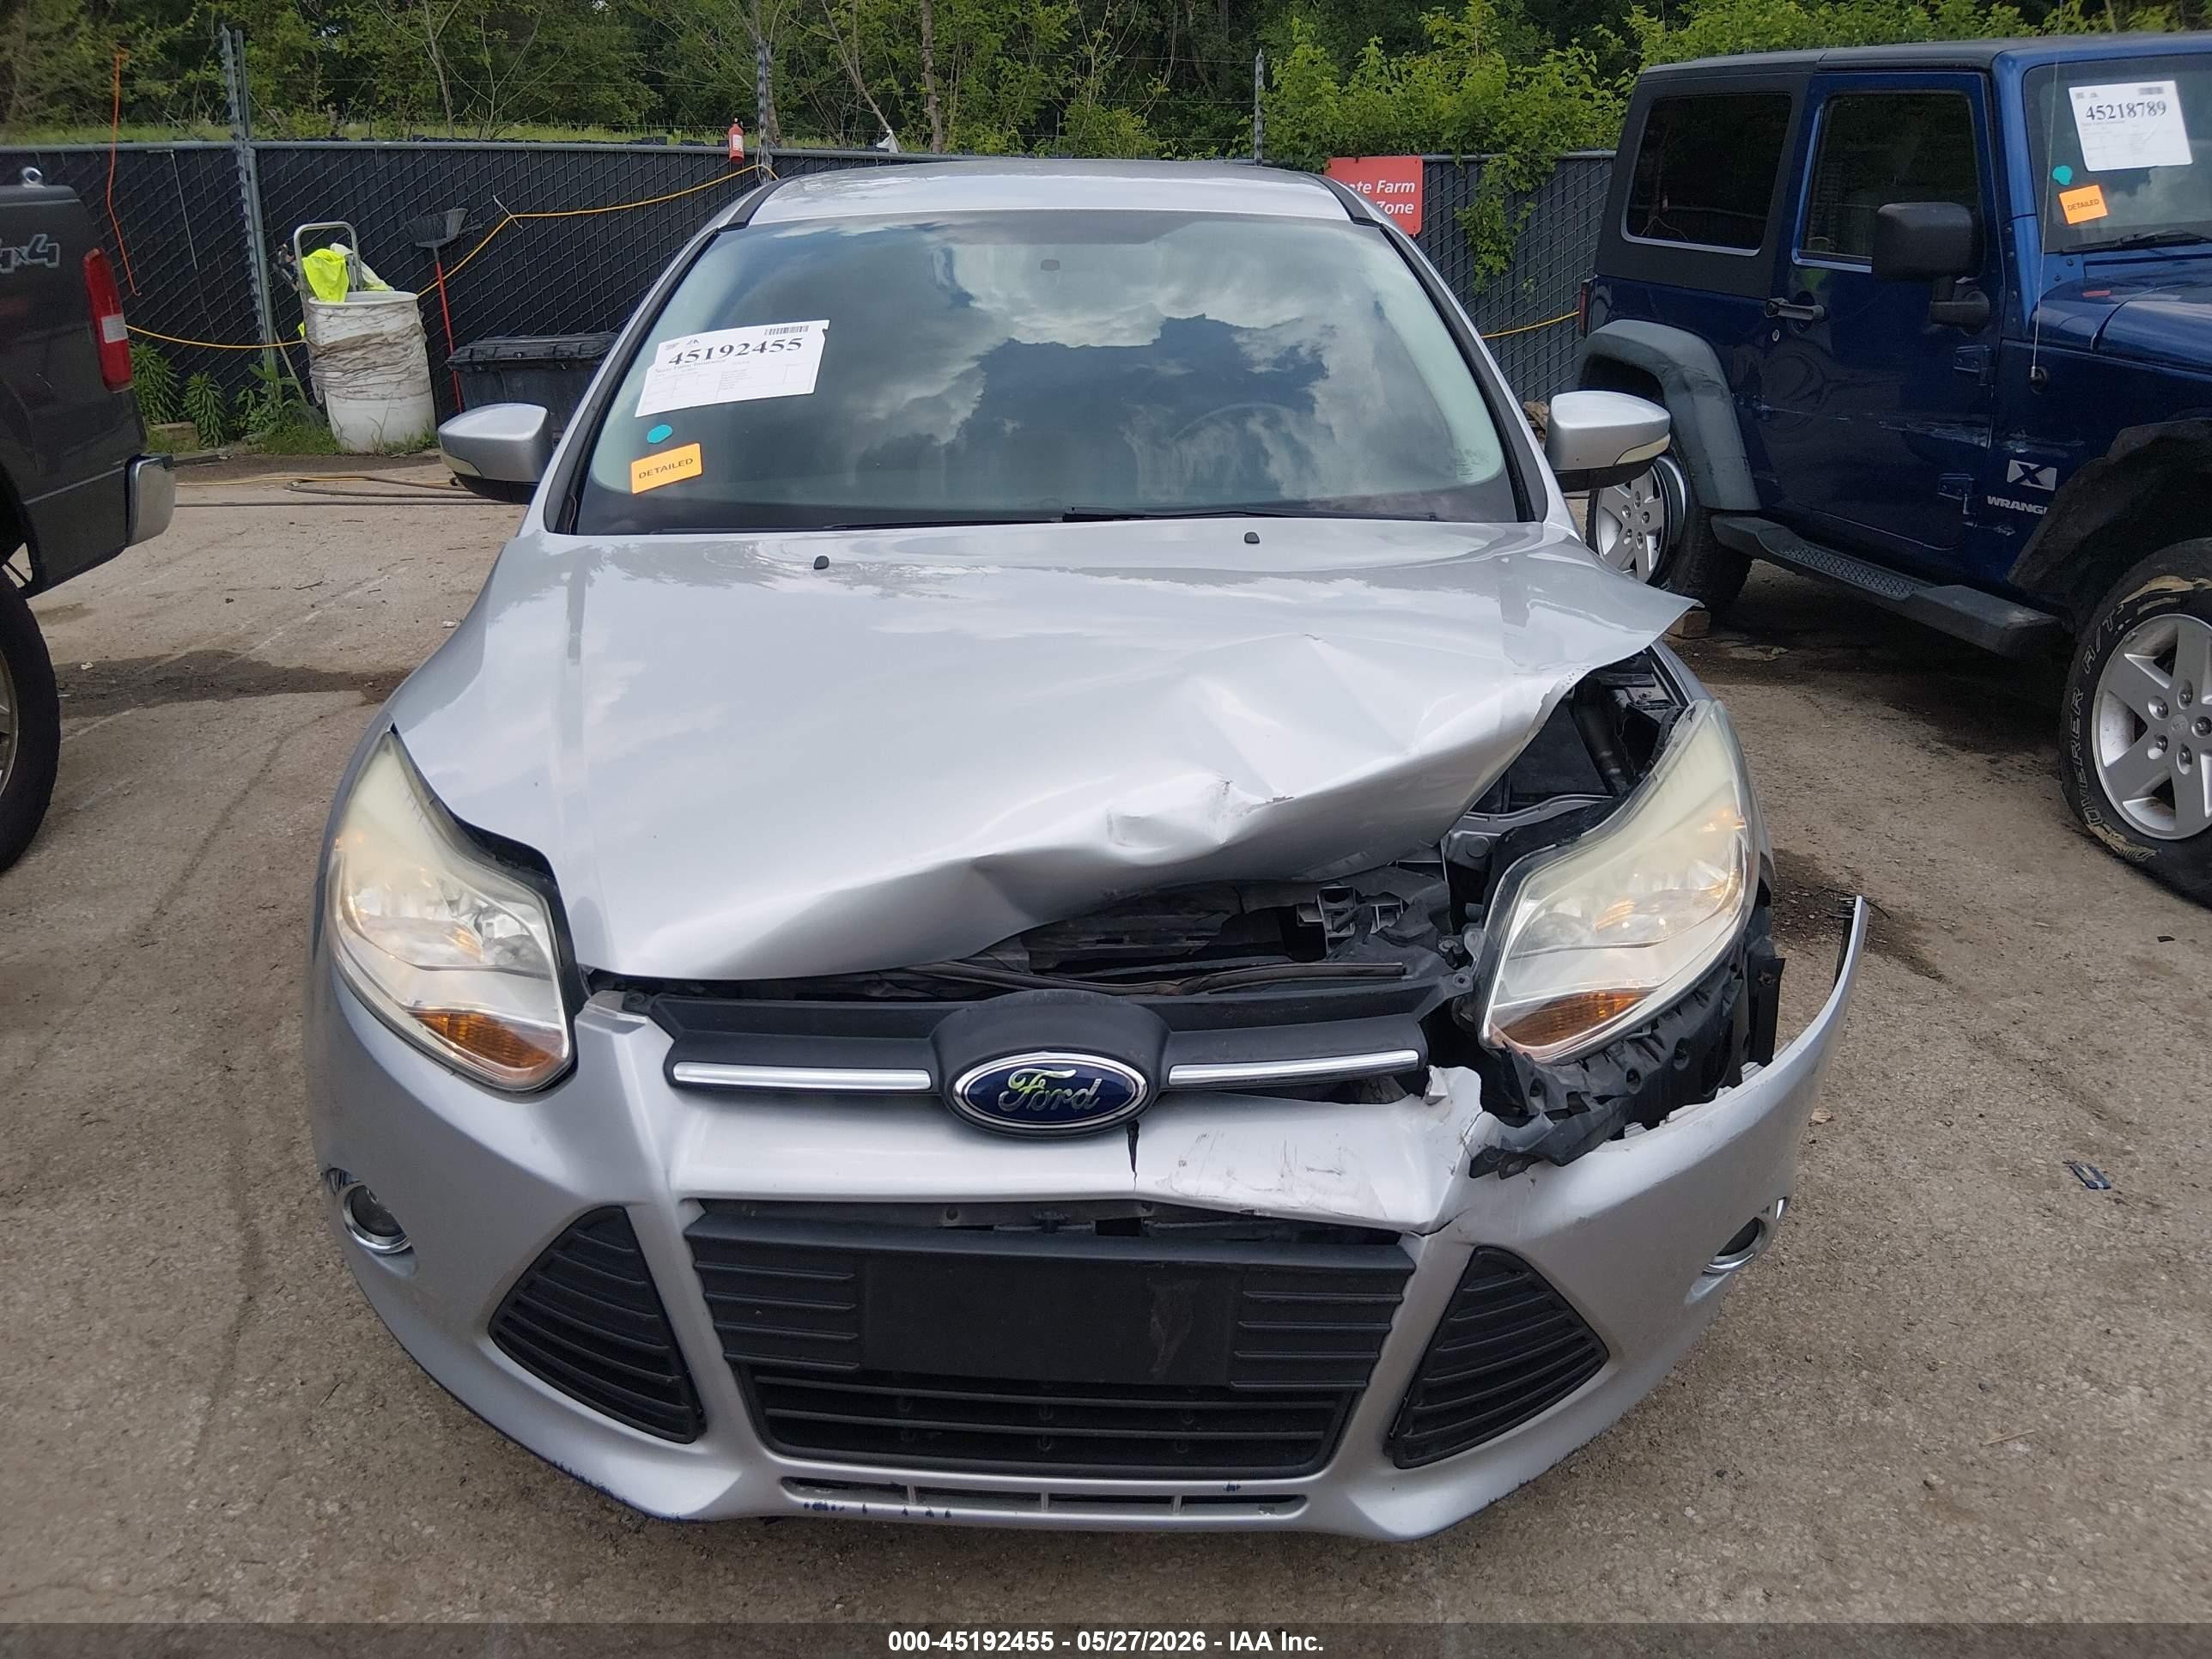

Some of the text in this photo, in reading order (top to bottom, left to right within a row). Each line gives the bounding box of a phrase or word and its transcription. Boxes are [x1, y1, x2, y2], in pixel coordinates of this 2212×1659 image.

[2086, 100, 2166, 121] 45218789
[1376, 179, 1415, 194] Farm
[2068, 199, 2100, 211] DETAILED
[668, 337, 803, 365] 45192455
[638, 458, 694, 479] DETAILED
[997, 1067, 1103, 1114] Ford
